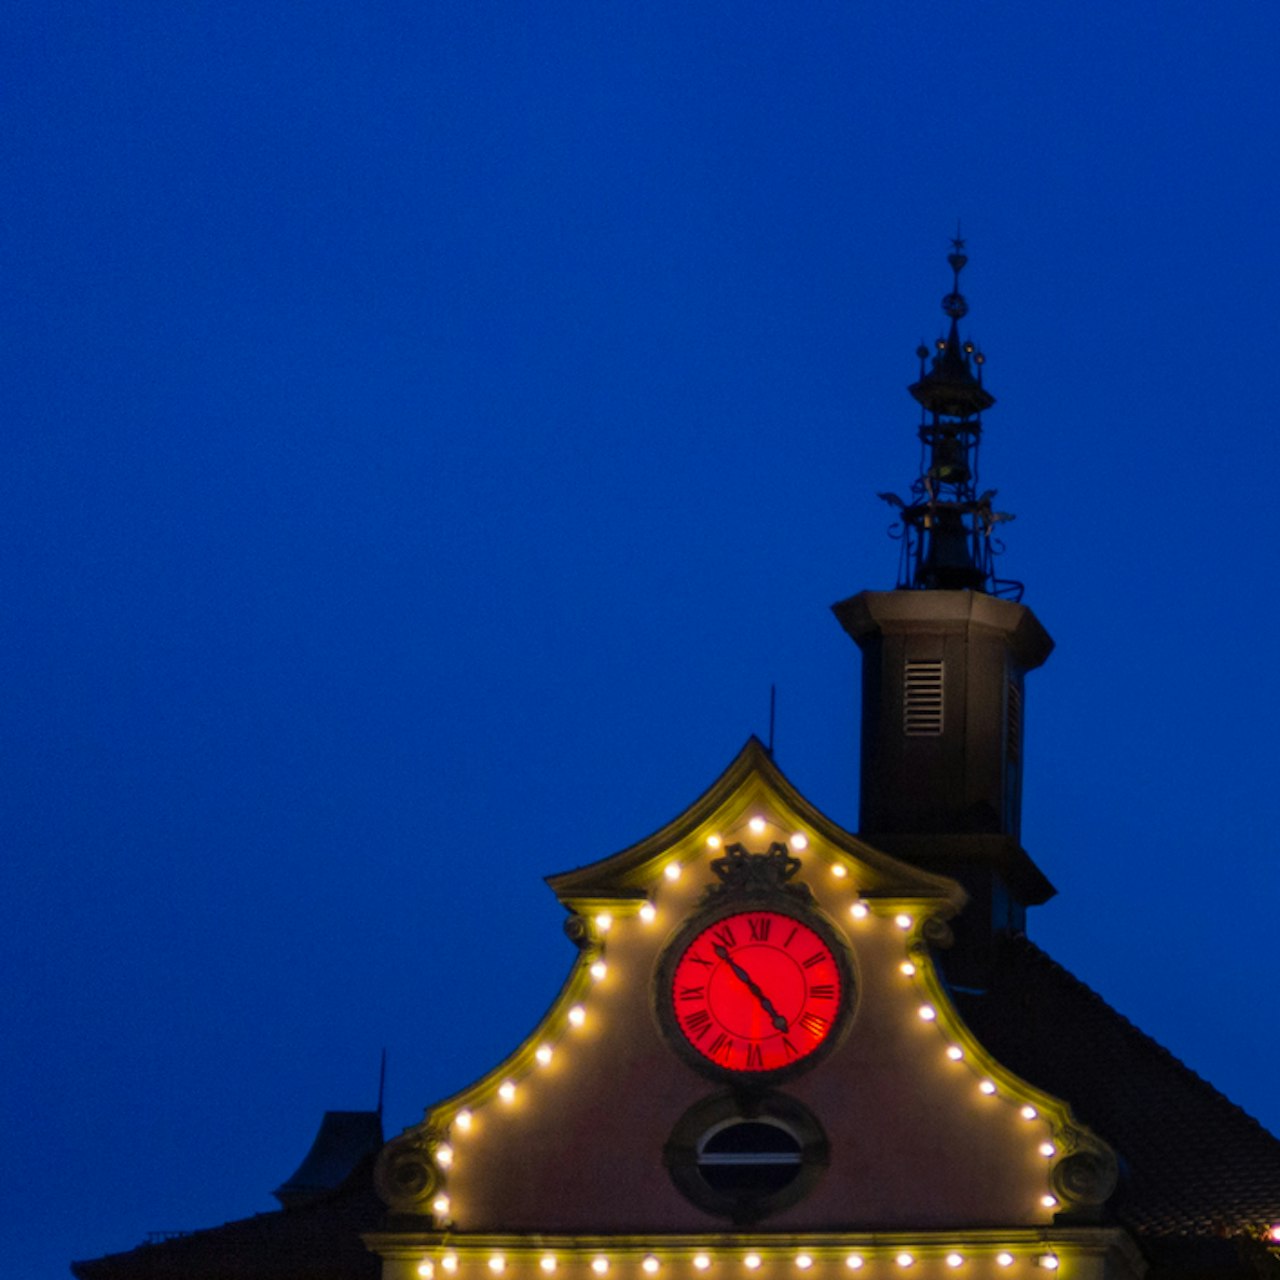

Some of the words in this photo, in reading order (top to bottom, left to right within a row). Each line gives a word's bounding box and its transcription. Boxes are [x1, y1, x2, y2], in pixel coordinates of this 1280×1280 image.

[748, 919, 770, 940] XII
[803, 952, 826, 969] II
[810, 985, 834, 999] III
